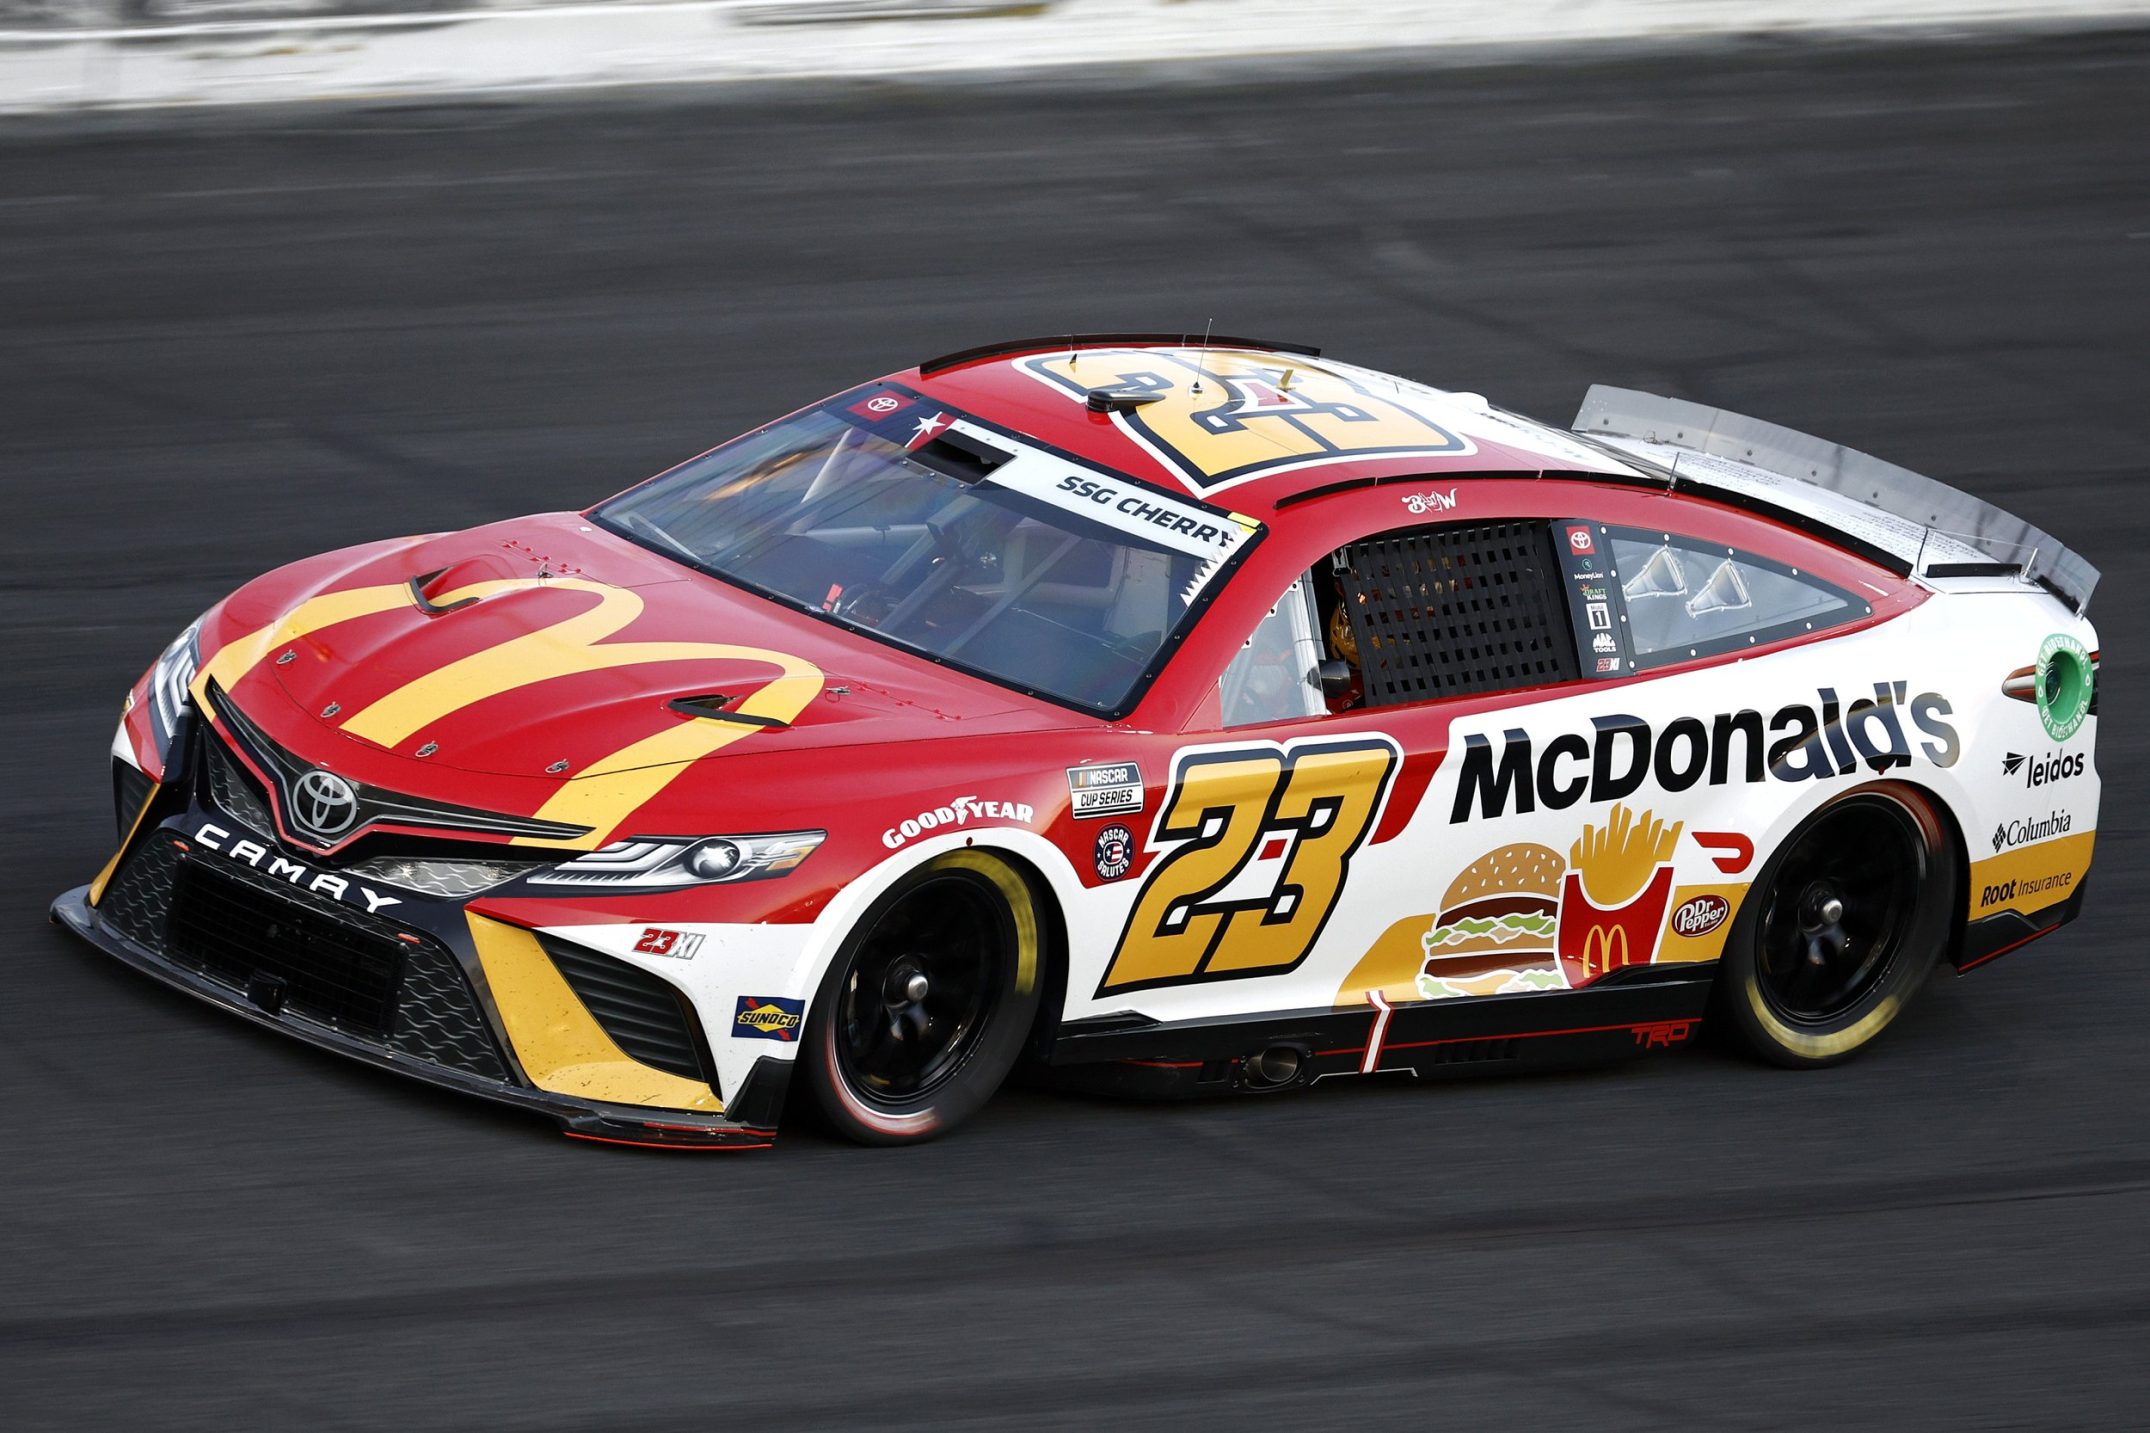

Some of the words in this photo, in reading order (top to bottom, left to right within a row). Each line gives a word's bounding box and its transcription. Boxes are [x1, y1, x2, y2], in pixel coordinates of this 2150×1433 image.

[1056, 476, 1118, 504] SSG
[1116, 498, 1236, 548] CHERRY
[1449, 680, 1961, 825] McDonald's
[2027, 748, 2085, 788] leidos
[1089, 768, 1129, 785] NASCAR
[1081, 792, 1099, 807] CUP
[1099, 789, 1133, 806] SERIES
[882, 796, 1034, 849] GOODYEAR
[1098, 828, 1129, 849] NASCAR
[2007, 809, 2072, 847] Columbia
[194, 823, 403, 914] CAMRY
[1092, 738, 1399, 1001] 23
[1098, 858, 1129, 878] SALUTES
[1980, 879, 2017, 908] Root
[2018, 871, 2072, 897] Insurance
[1676, 903, 1725, 933] Pepper
[1695, 899, 1715, 916] Dr
[631, 927, 707, 960] 23XI
[739, 1012, 800, 1029] SUNOCO
[1631, 1022, 1690, 1049] TRD
